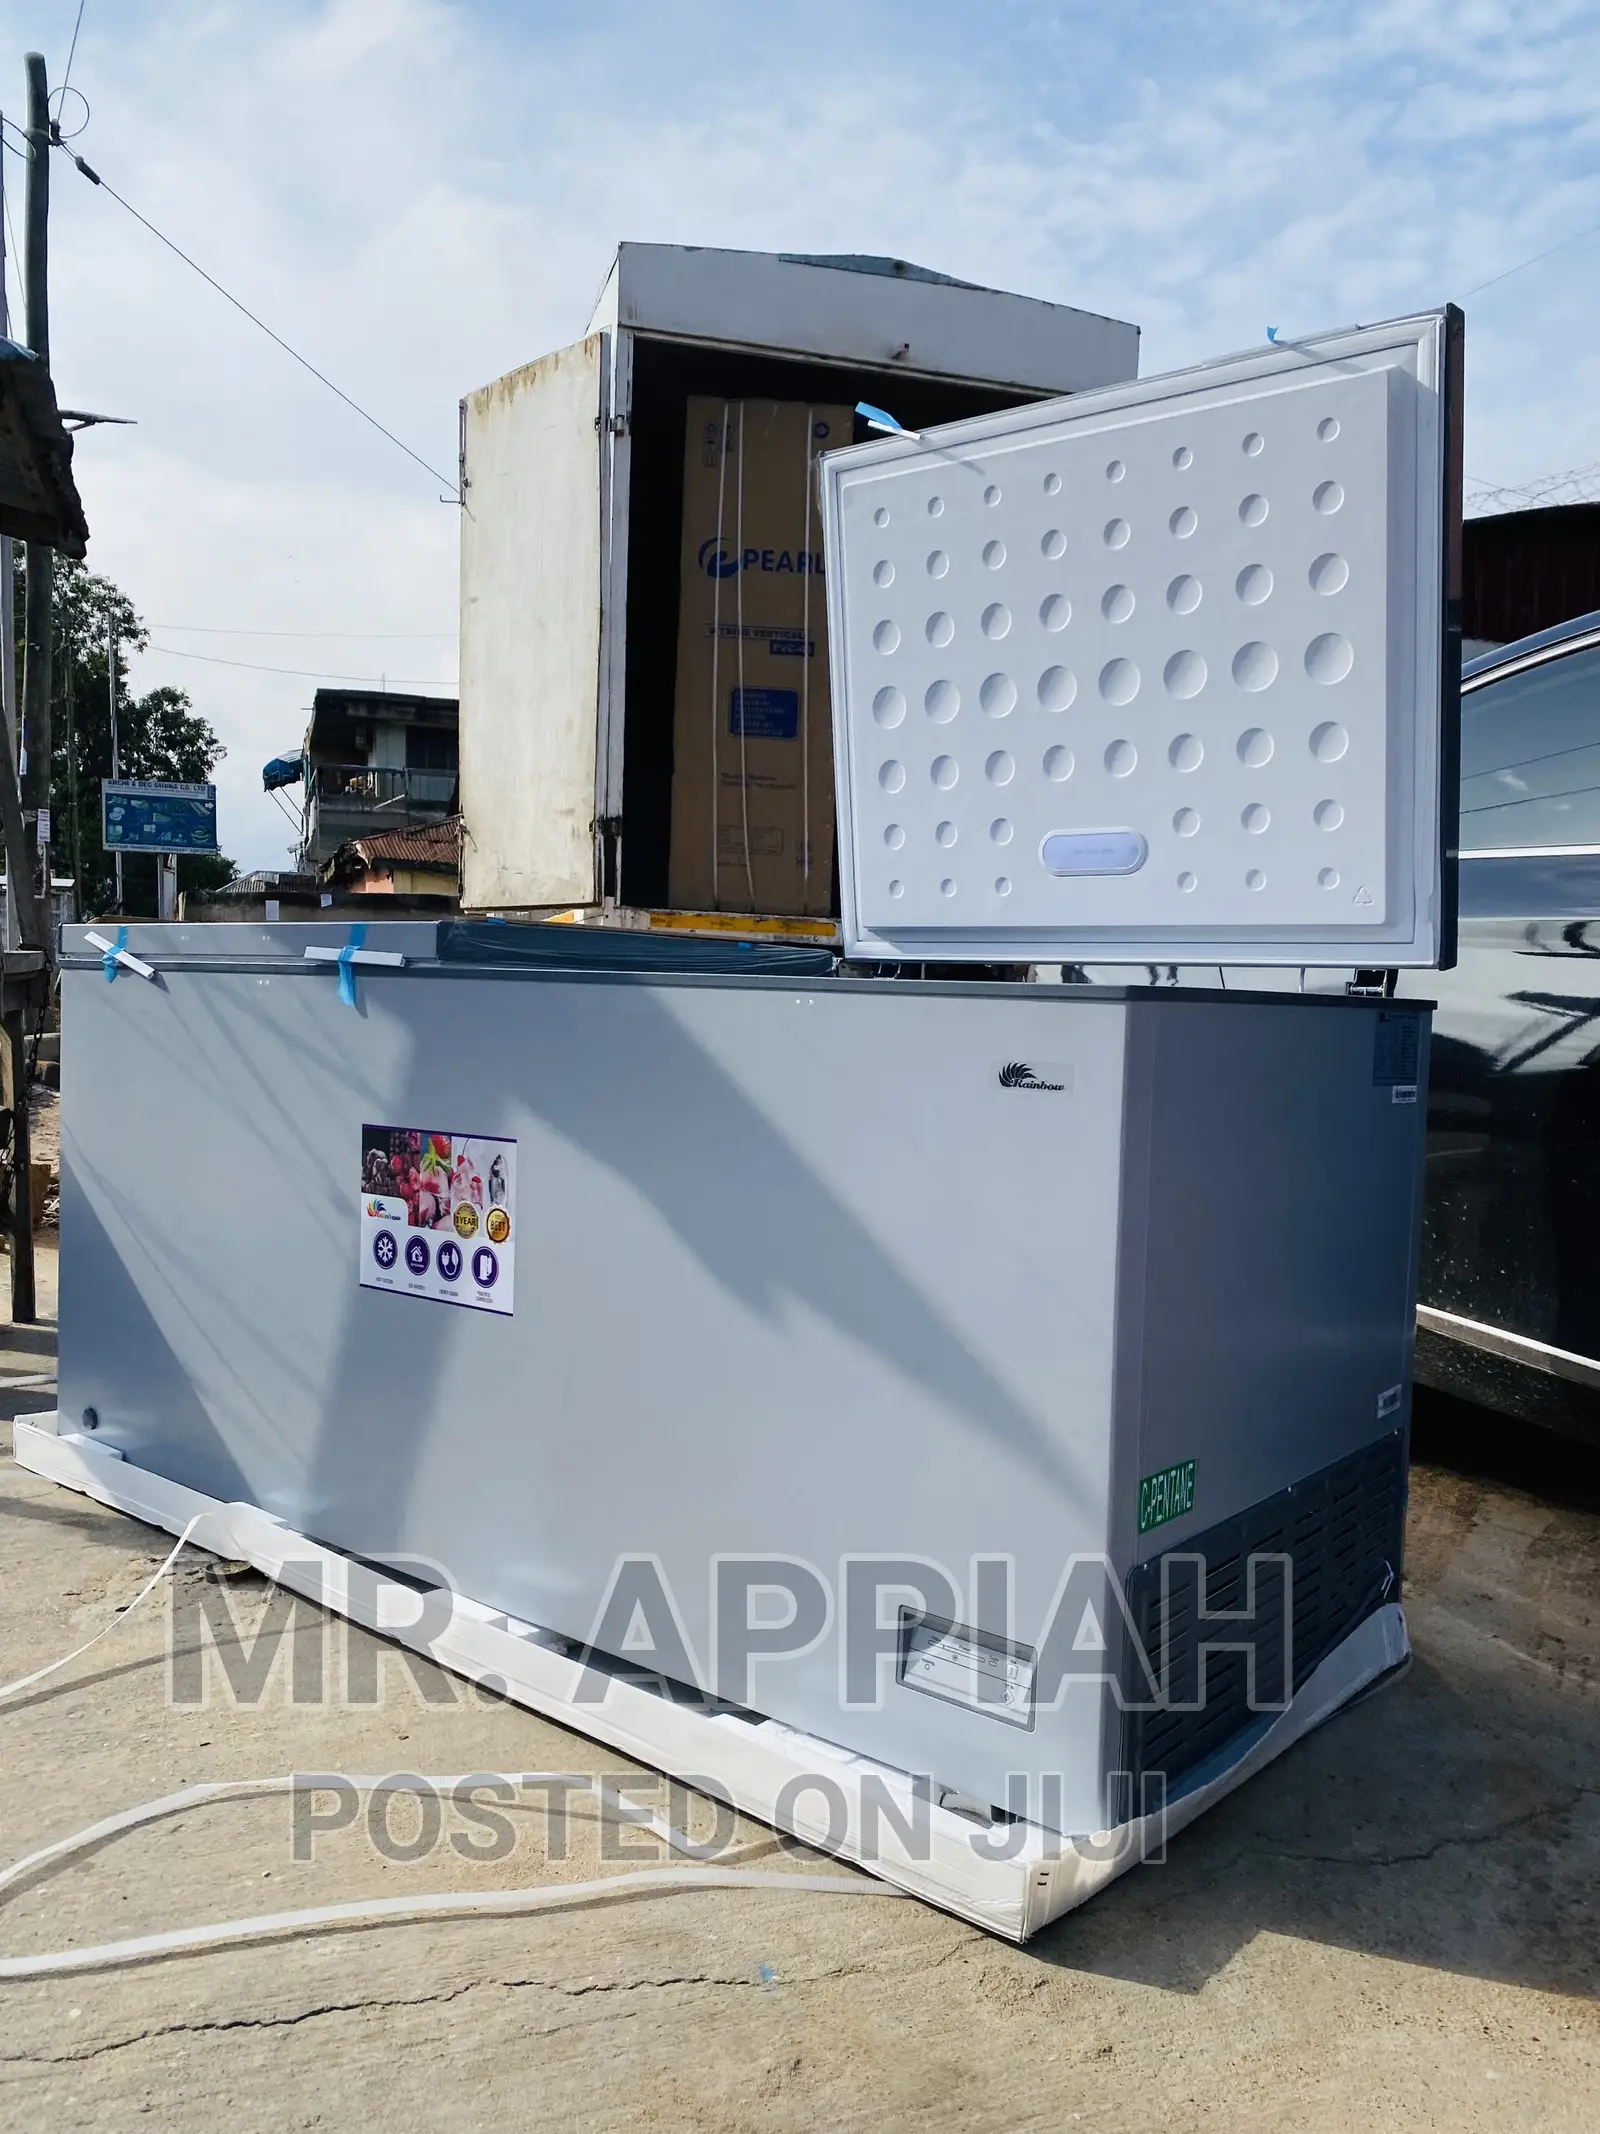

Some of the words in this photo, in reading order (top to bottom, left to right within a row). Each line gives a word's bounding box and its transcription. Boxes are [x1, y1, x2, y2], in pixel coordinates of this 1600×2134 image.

[742, 548, 826, 574] PEARL
[1011, 1077, 1065, 1091] Rainbow
[460, 1215, 476, 1227] YEAR
[1140, 1462, 1195, 1529] C-PENTANE
